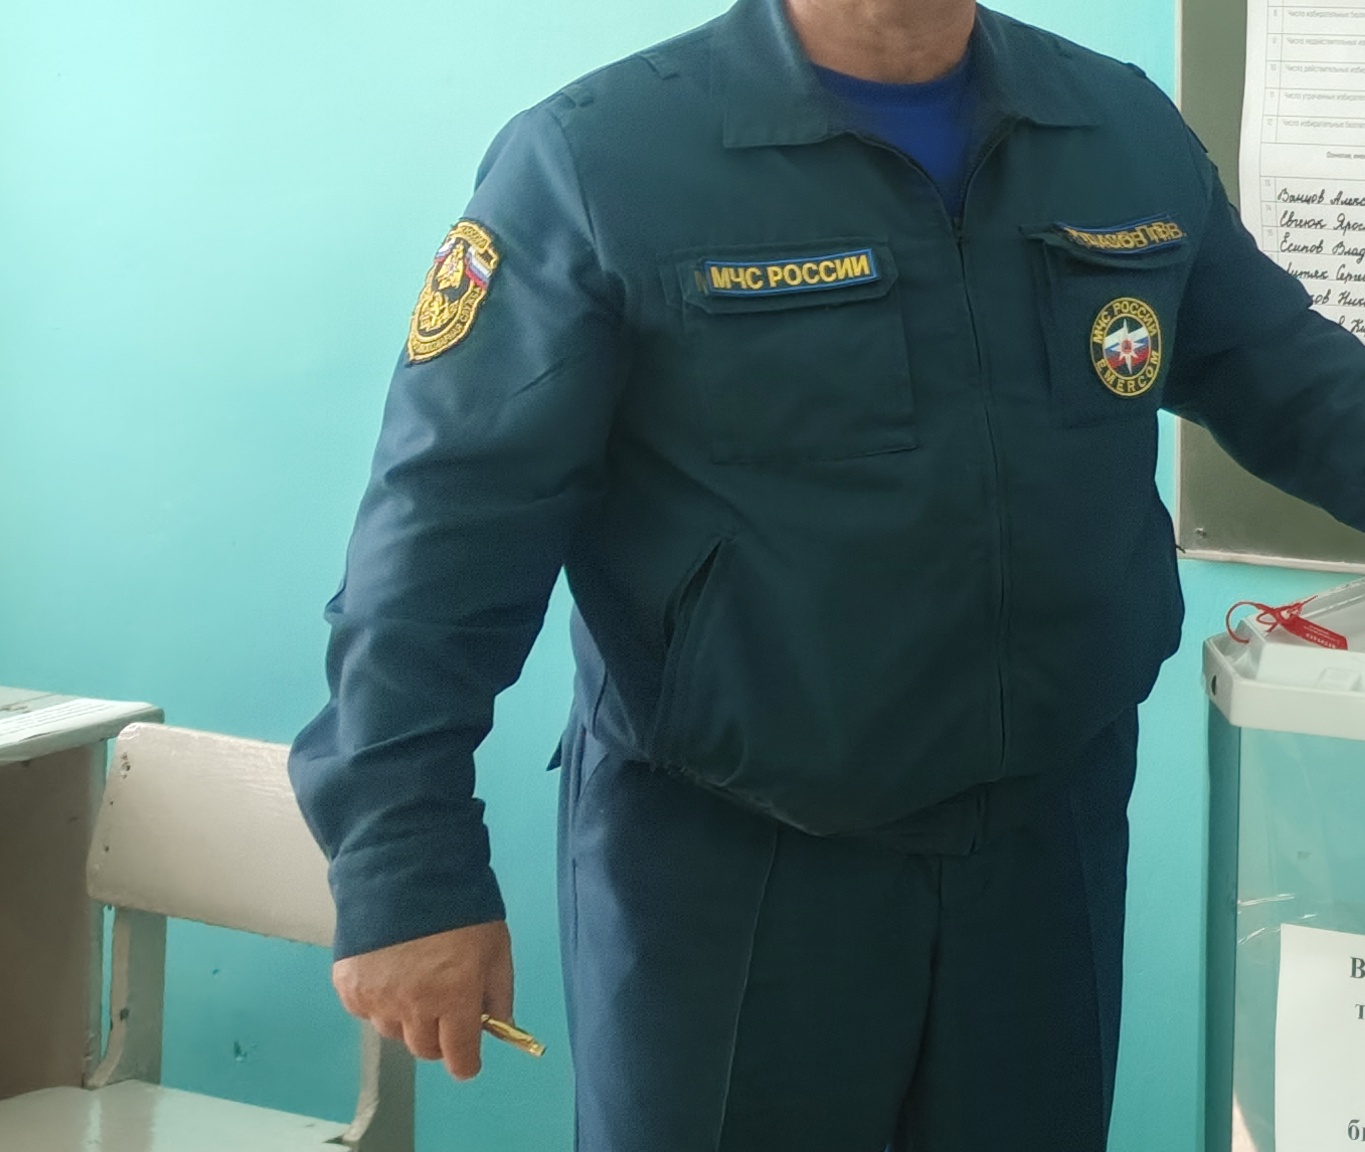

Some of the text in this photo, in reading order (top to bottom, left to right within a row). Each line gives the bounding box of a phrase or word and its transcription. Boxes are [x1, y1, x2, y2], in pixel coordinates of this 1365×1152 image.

[710, 254, 870, 289] МЧС РОССИИ
[1093, 311, 1111, 344] МЧС
[1113, 301, 1157, 336] РОССИИ
[1096, 350, 1159, 393] EMERCOM
[1350, 957, 1365, 979] В
